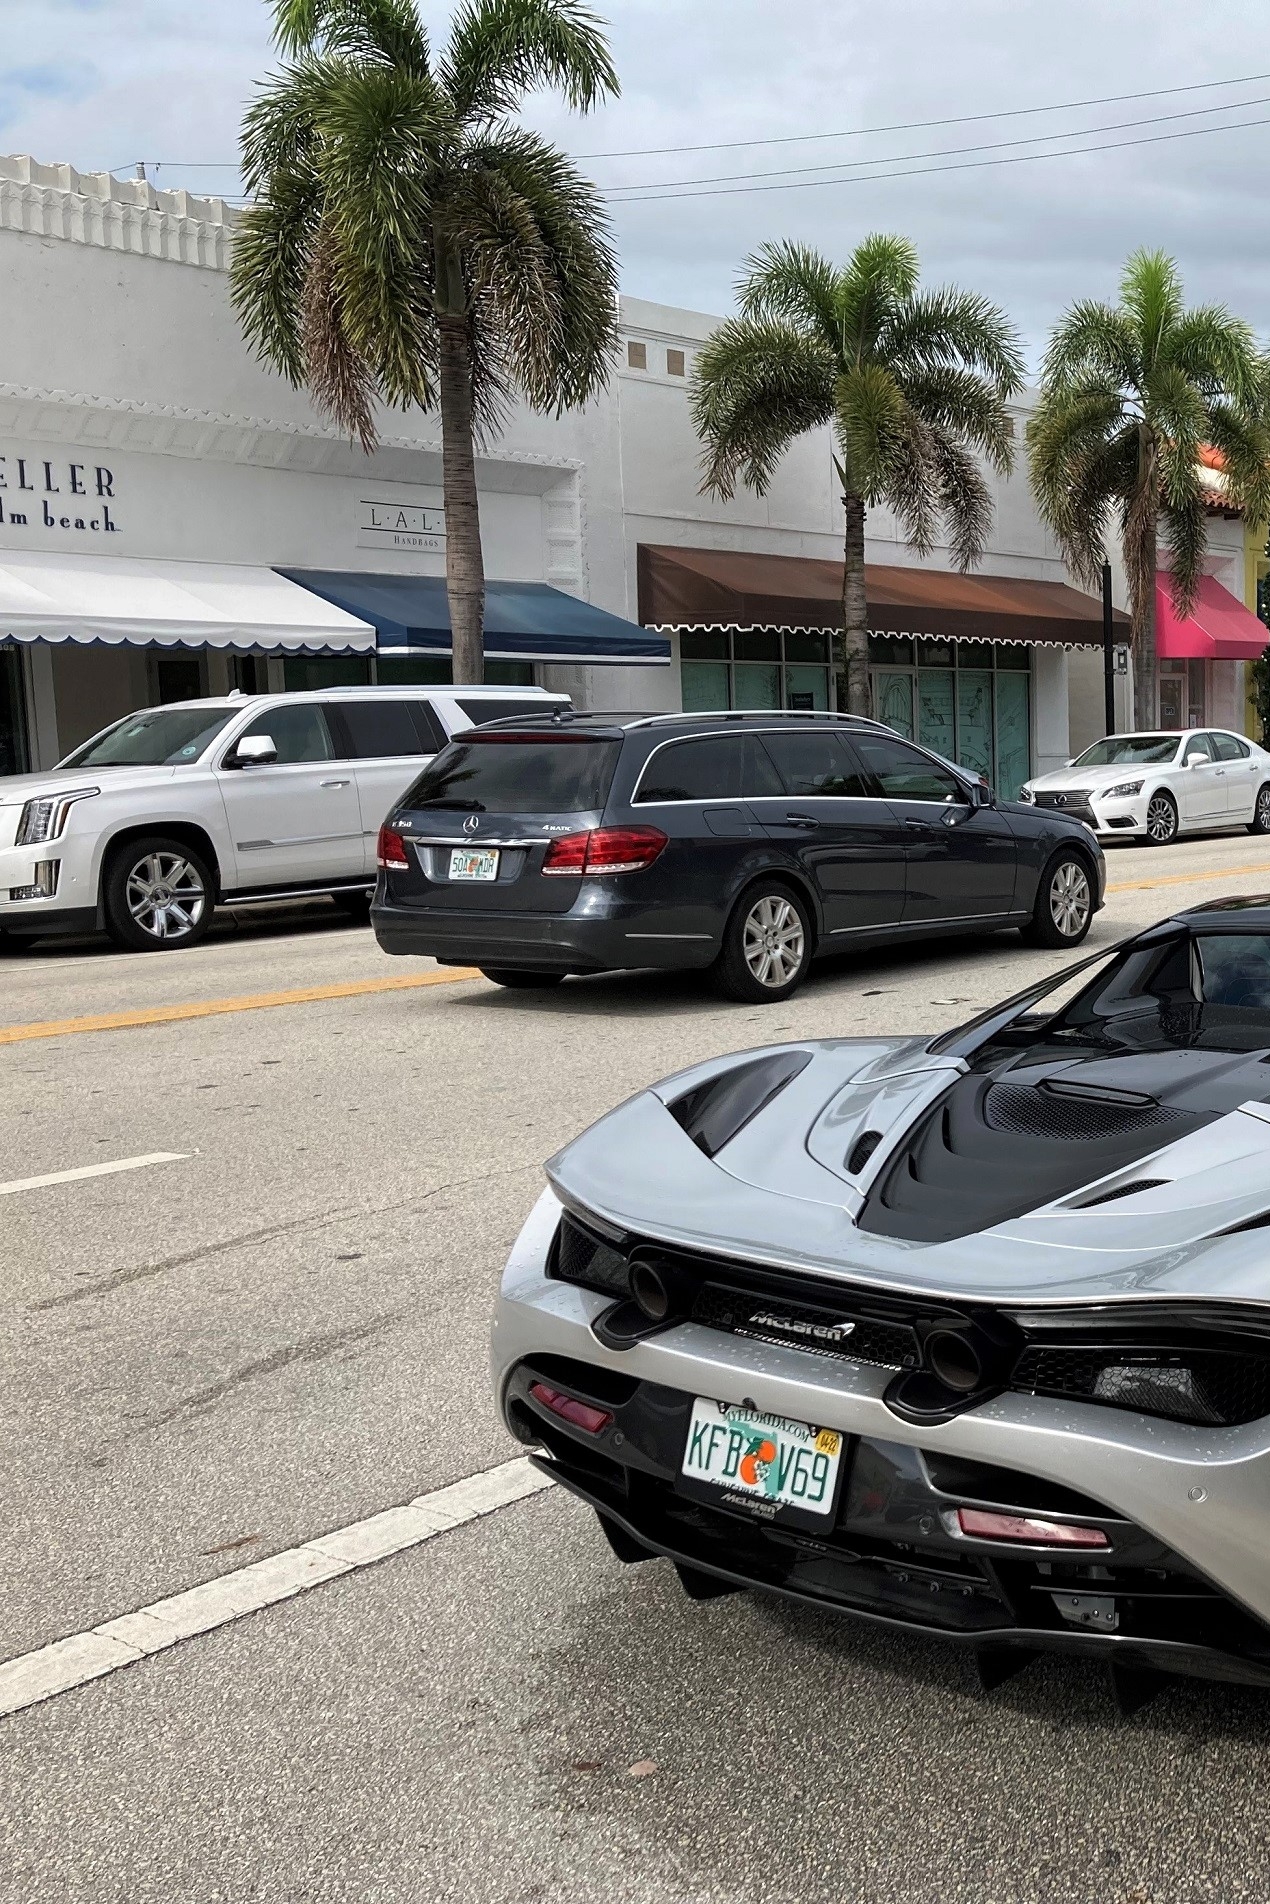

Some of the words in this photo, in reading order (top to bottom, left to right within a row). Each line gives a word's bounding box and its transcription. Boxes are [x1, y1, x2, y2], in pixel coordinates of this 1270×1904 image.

[42, 500, 123, 533] beach
[394, 535, 439, 547] HANDBAGS
[749, 1311, 842, 1341] McLaren
[688, 1419, 743, 1478] KFB
[777, 1442, 830, 1502] V69
[720, 1493, 780, 1514] McLaren
